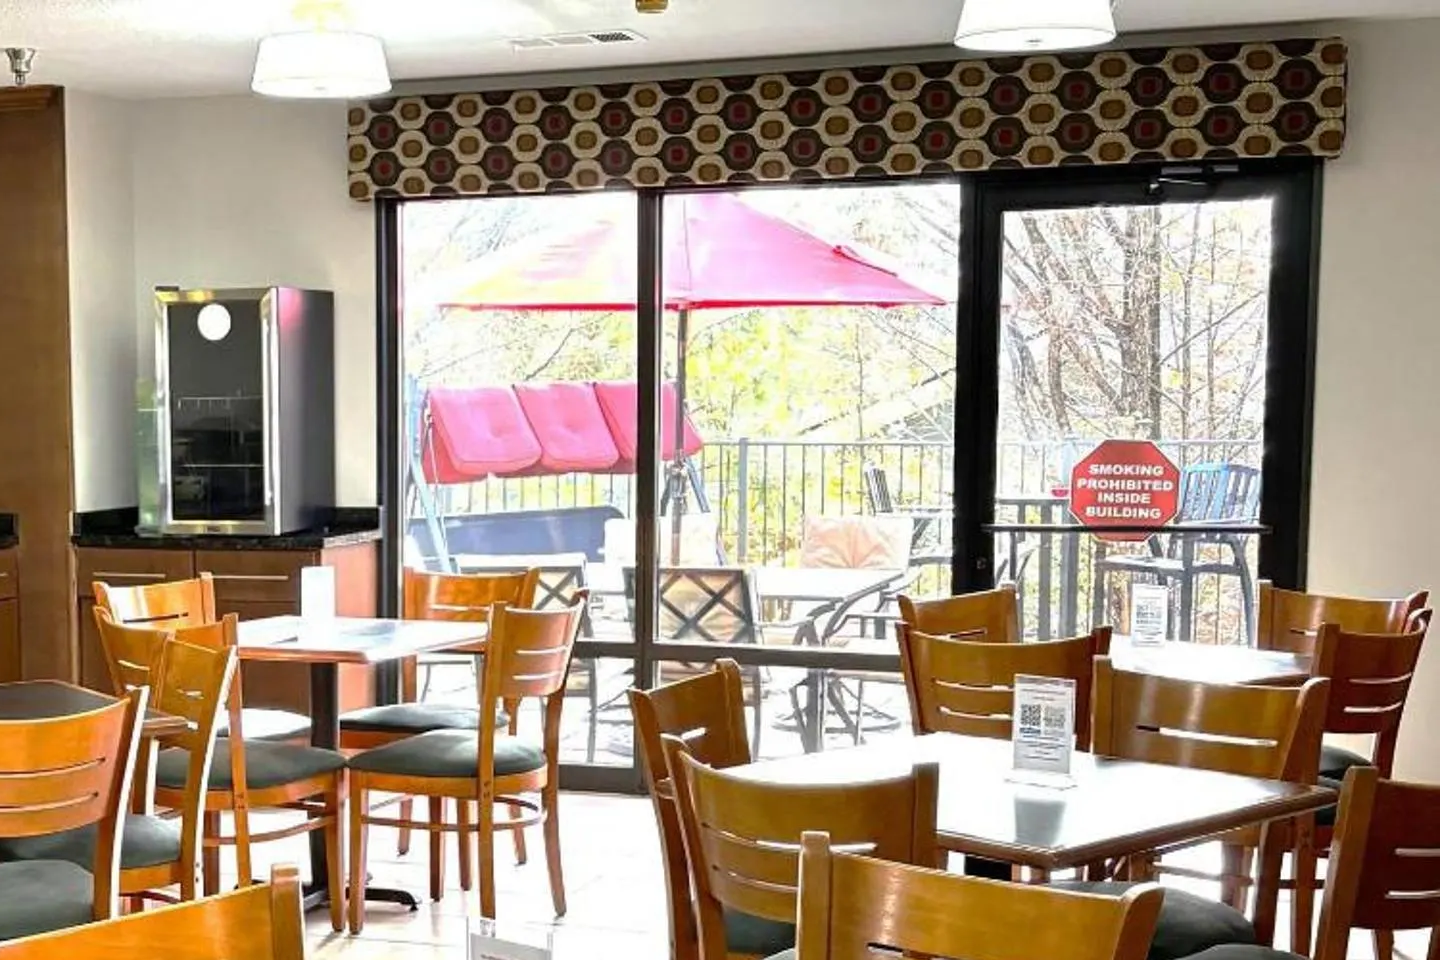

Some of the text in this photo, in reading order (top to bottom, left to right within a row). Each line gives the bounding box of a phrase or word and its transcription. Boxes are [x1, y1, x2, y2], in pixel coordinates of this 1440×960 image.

[1088, 463, 1165, 476] SMOKING
[1076, 478, 1174, 491] PROHIBITED
[1097, 491, 1152, 504] INSIDE
[1085, 506, 1162, 519] BUILDING
